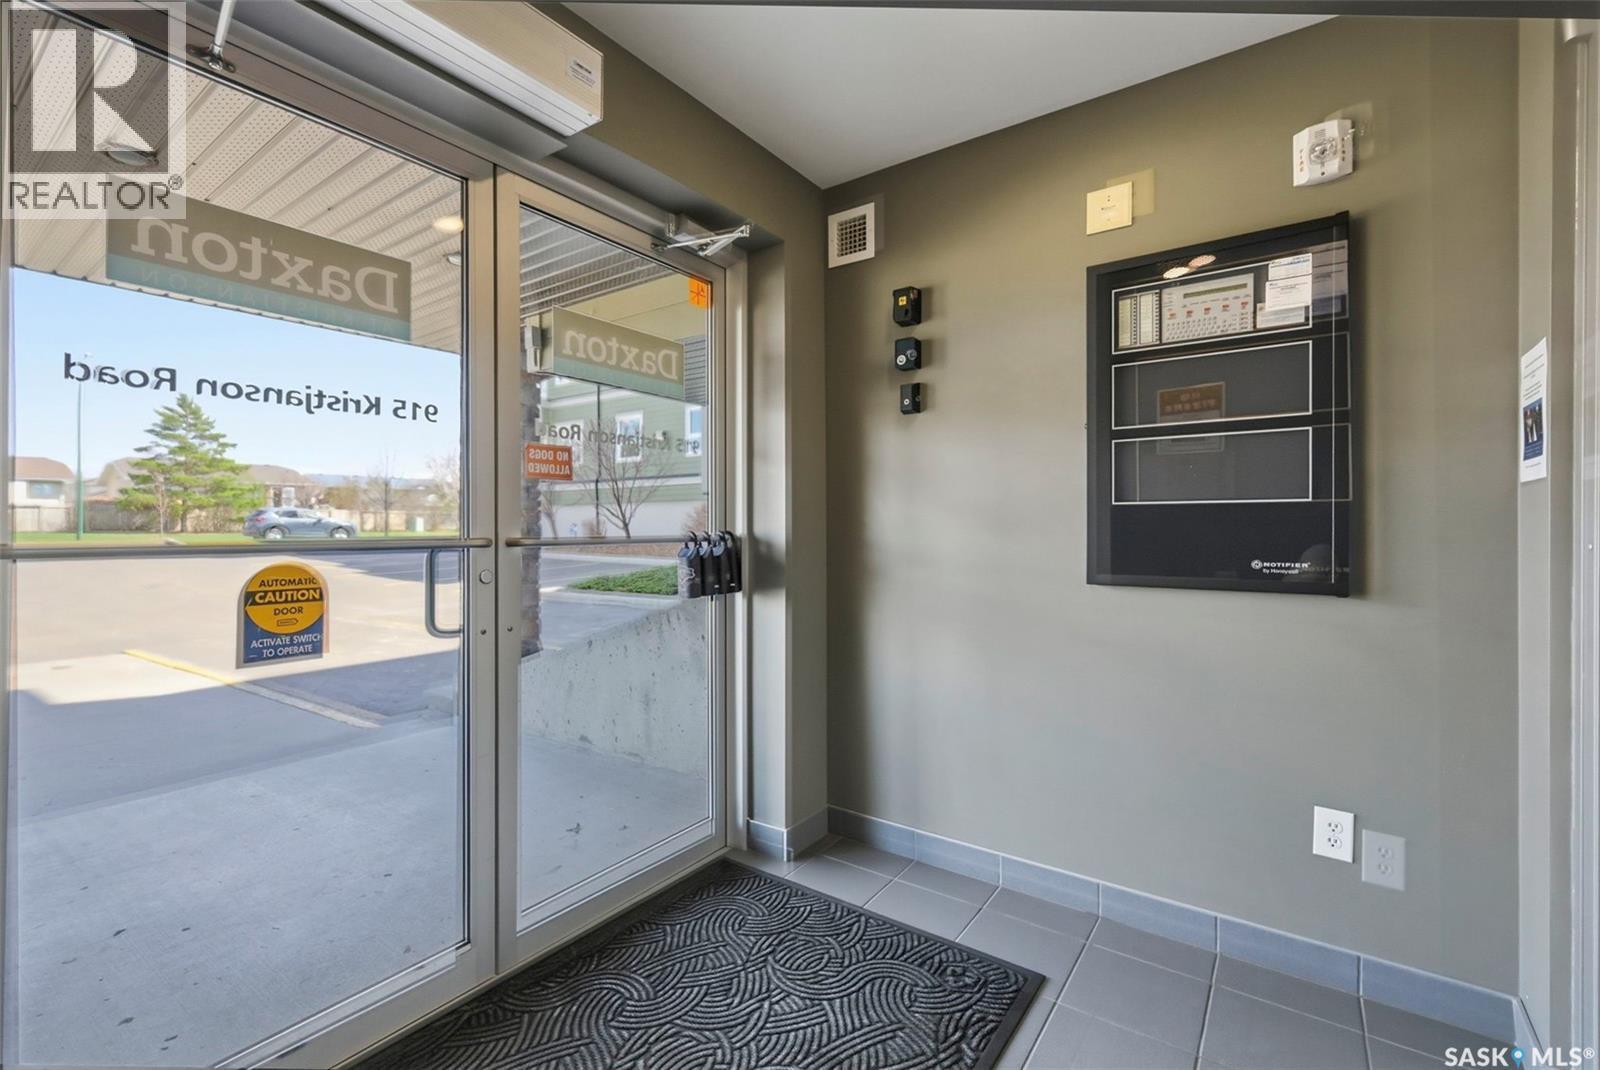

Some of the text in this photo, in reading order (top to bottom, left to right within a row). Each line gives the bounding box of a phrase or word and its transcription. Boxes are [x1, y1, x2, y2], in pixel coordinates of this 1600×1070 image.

[258, 577, 318, 588] AUTOMATIC
[254, 589, 320, 604] CAUTION
[273, 606, 304, 616] DOOR
[250, 635, 291, 649] ACTIVATE
[262, 644, 313, 658] TO OPERATE
